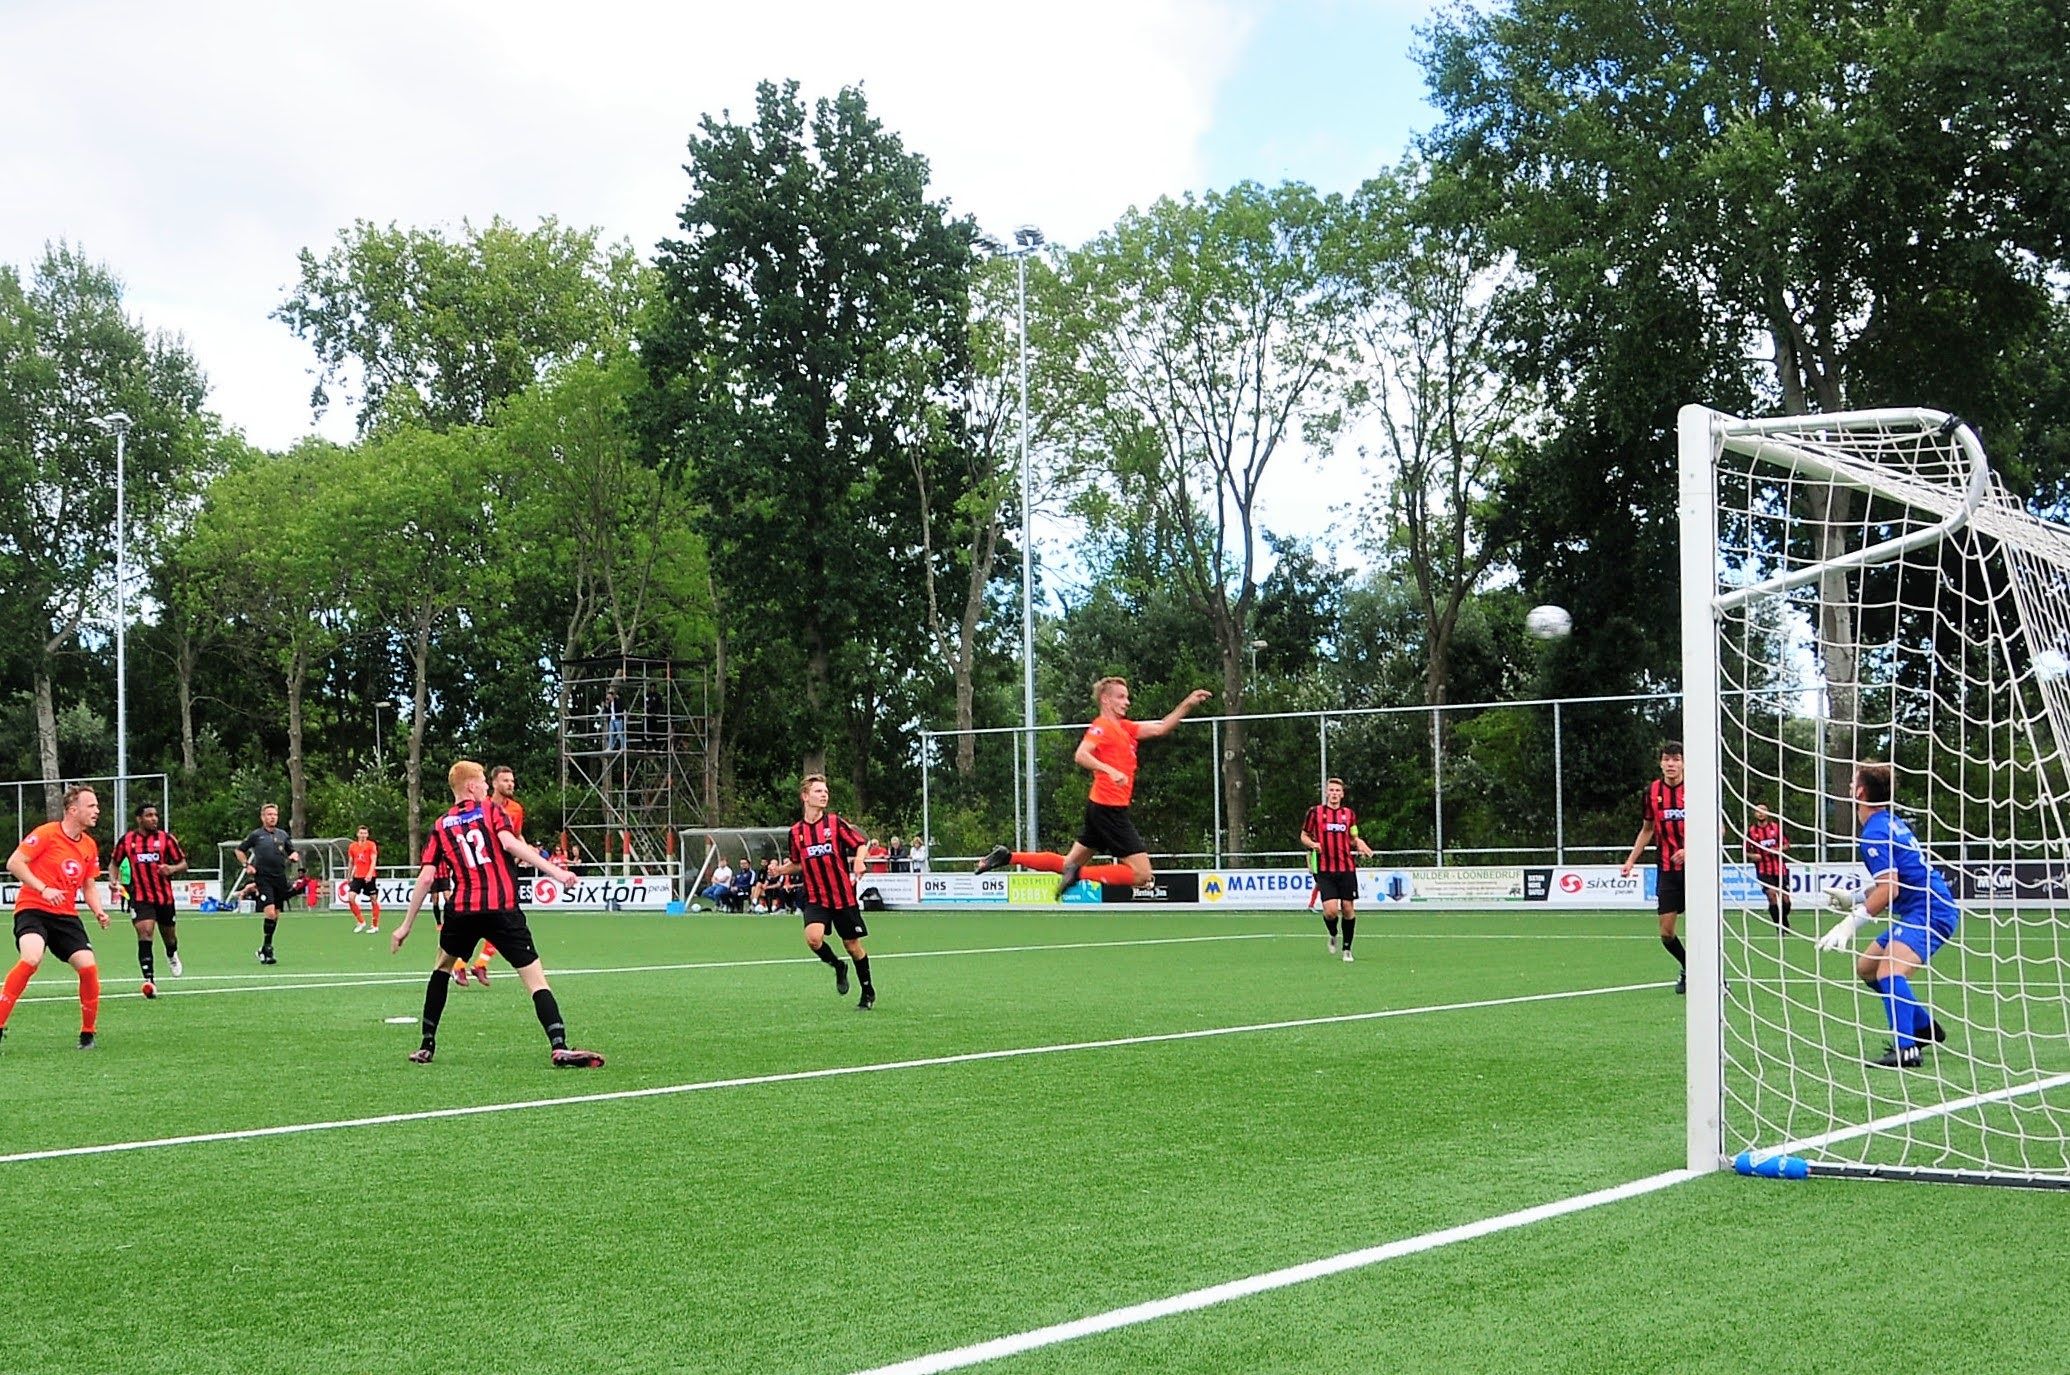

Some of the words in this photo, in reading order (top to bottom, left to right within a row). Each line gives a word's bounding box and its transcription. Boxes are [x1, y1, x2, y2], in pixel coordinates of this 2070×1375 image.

[456, 829, 492, 868] 12
[806, 843, 832, 857] EPRO
[1412, 871, 1450, 880] MULDER
[1457, 870, 1520, 880] LOONBEDRIJF
[924, 881, 946, 891] ONS
[982, 881, 1004, 891] ONS
[1586, 877, 1637, 889] sixton
[562, 881, 647, 903] sixton
